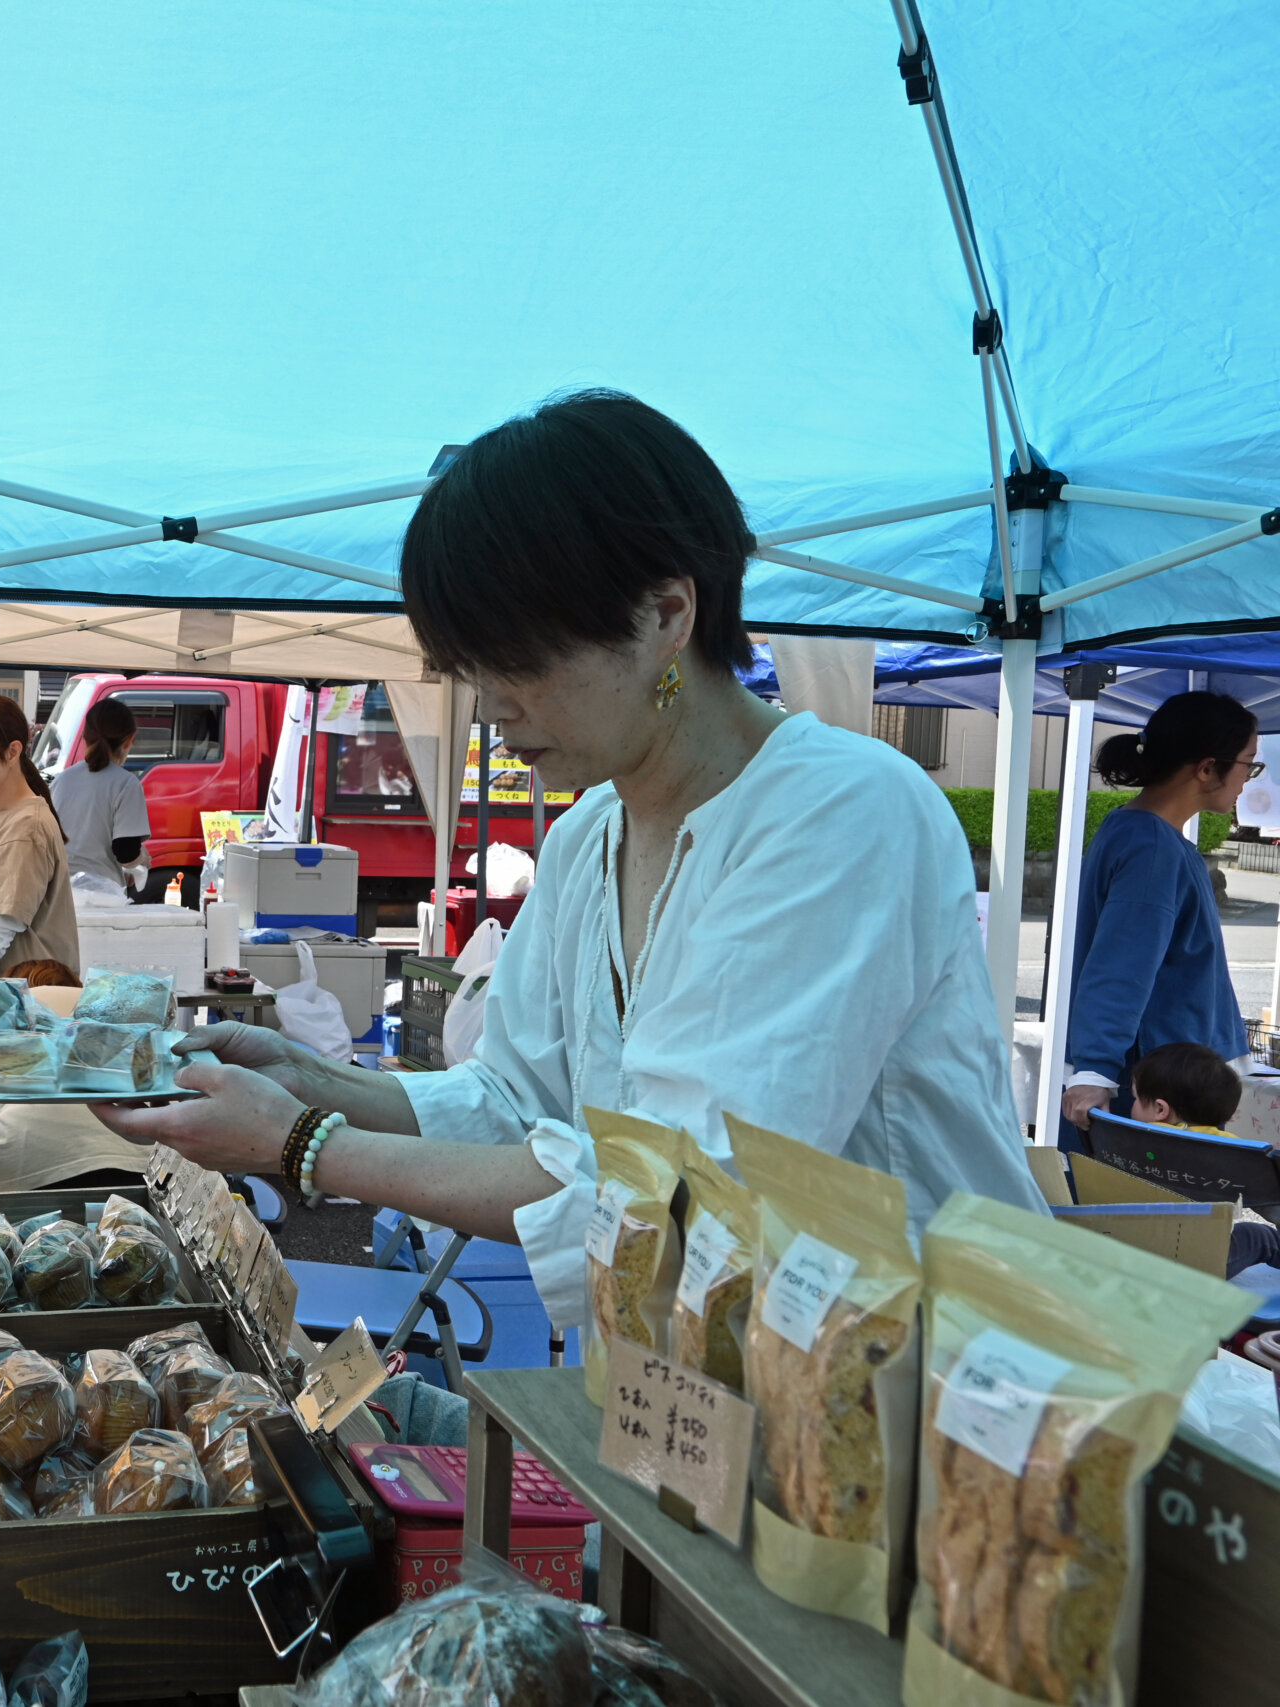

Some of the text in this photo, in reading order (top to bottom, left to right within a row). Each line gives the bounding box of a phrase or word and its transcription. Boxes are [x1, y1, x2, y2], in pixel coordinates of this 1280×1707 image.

[496, 792, 520, 800] つくね
[782, 1269, 805, 1289] FOR
[195, 1538, 258, 1556] おやつ工房
